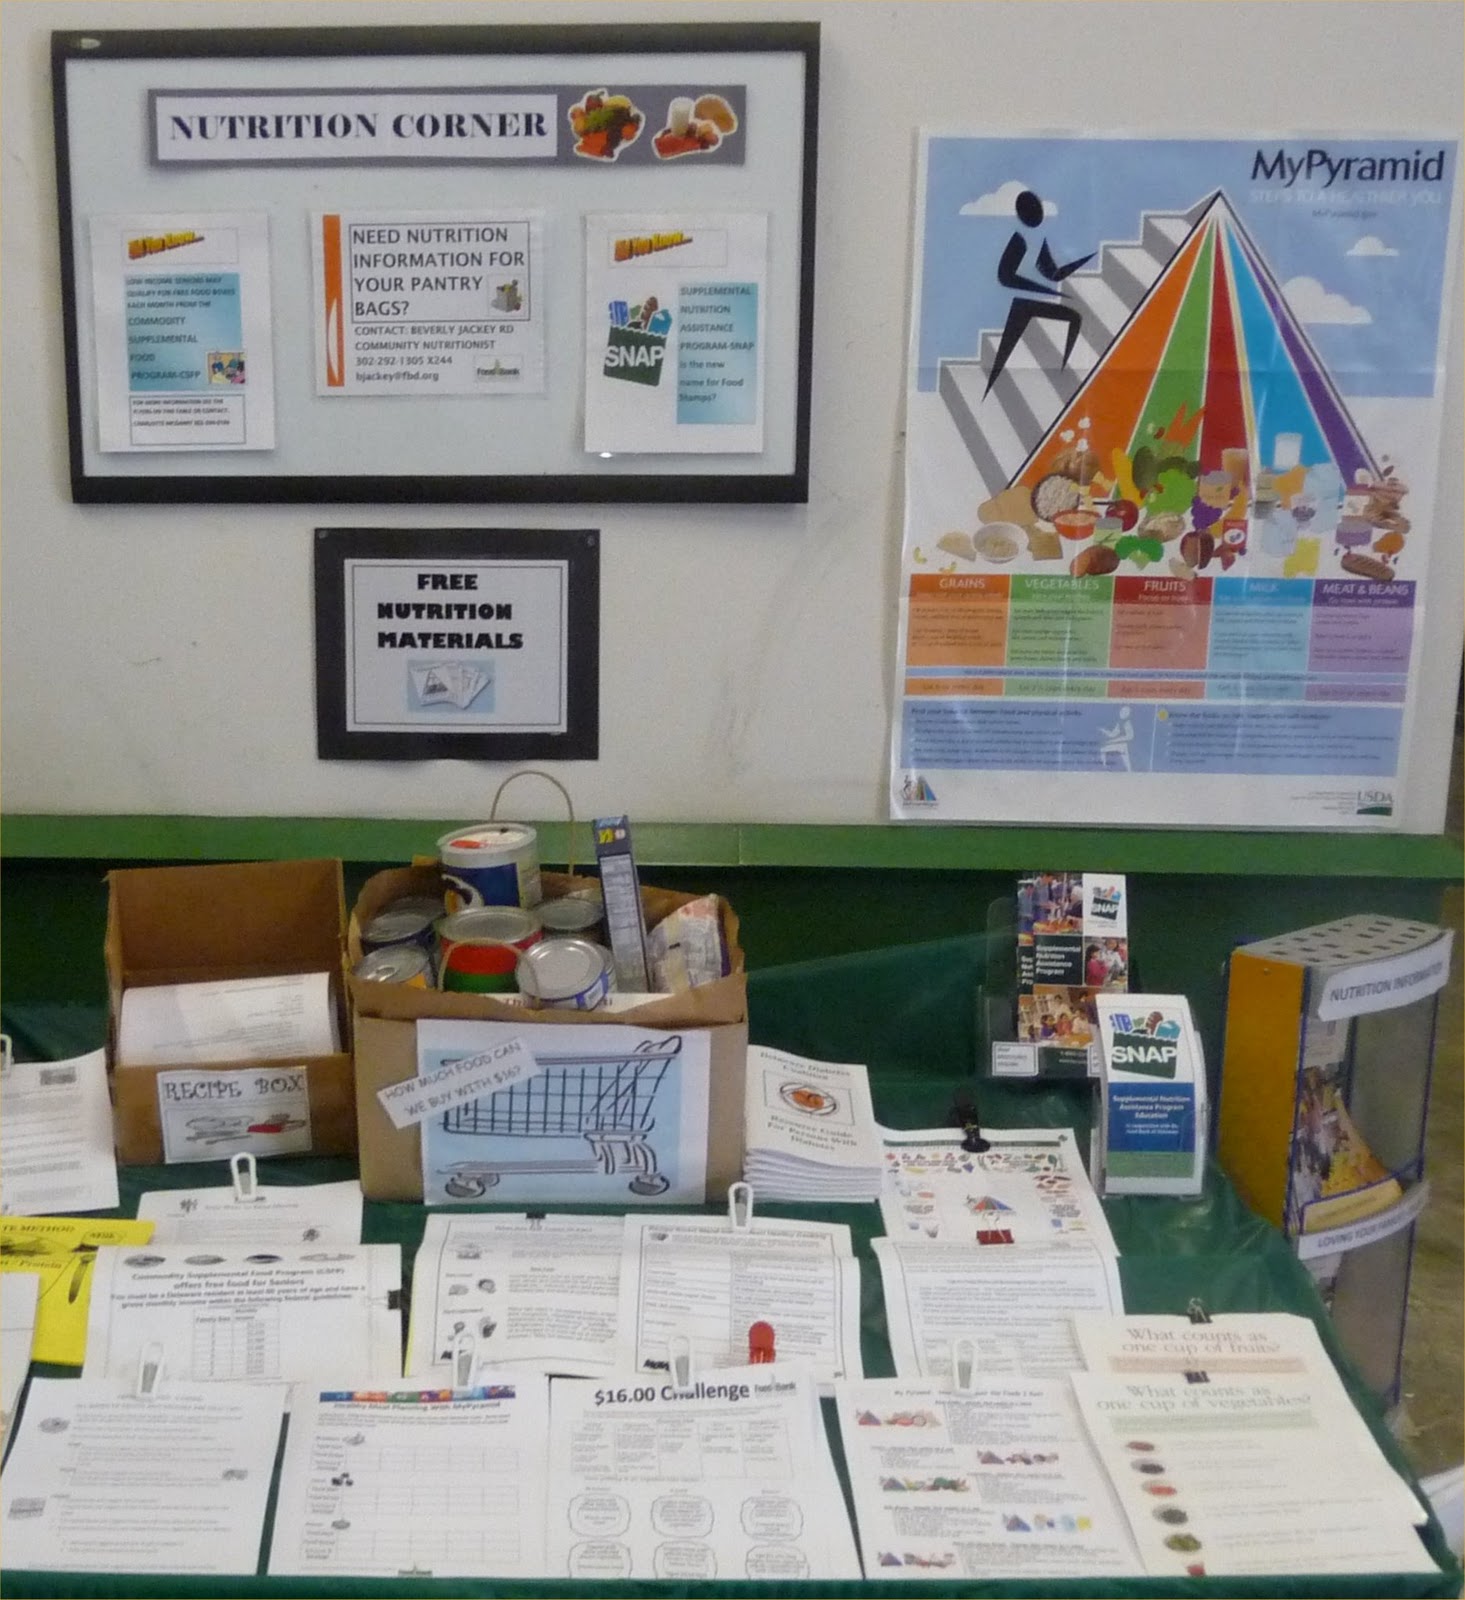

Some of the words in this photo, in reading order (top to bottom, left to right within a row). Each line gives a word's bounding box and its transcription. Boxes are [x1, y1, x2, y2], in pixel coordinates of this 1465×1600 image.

[170, 113, 378, 140] NUTRITION
[392, 111, 548, 138] CORNER
[1251, 149, 1445, 188] MyPyramid
[353, 229, 400, 244] NEED
[407, 227, 508, 243] NUTRITION
[354, 252, 482, 268] INFORMATION
[489, 251, 525, 266] FOR
[354, 277, 404, 292] YOUR
[411, 276, 483, 291] PANTRY
[679, 286, 751, 296] SUPPLEMENTAL
[355, 301, 409, 316] BAGS?
[679, 304, 731, 314] NUTRITION
[128, 316, 187, 326] COMMODITY
[411, 325, 455, 335] BEVERLY
[457, 325, 496, 335] JACKEY
[499, 325, 514, 334] RD
[679, 323, 734, 332] ASSISTANCE
[128, 334, 199, 345] SUPPLEMENTAL
[355, 341, 420, 351] COMMUNITY
[422, 340, 496, 350] NUTRITIONIST
[679, 341, 755, 351] PROGRAM-SNAP
[130, 353, 156, 362] FOOD
[604, 345, 666, 368] SNAP
[689, 360, 704, 369] the
[706, 361, 725, 369] new
[679, 379, 704, 387] name
[706, 378, 720, 387] for
[721, 378, 744, 387] Food
[679, 392, 717, 403] Stamps?
[417, 573, 478, 591] FREE
[938, 578, 986, 590] GRAINS
[1024, 578, 1100, 590] VEGETABLES
[1143, 580, 1187, 592] FRUITS
[1322, 583, 1356, 595] MEAT
[1357, 583, 1367, 595] &
[1368, 584, 1410, 596] BEANS
[377, 602, 512, 620] NUTRITION
[377, 631, 524, 650] MATERIALS
[1357, 791, 1393, 802] USDA
[1091, 902, 1119, 914] SNAP
[1036, 944, 1081, 952] Supplemental
[1036, 952, 1065, 960] Nutrition
[1036, 960, 1073, 968] Assistance
[1036, 967, 1065, 976] Program
[1330, 979, 1392, 1001] NUTRITION
[1110, 1045, 1178, 1065] SNAP
[384, 1082, 416, 1100] HOW
[418, 1069, 456, 1088] MUCH
[455, 1053, 493, 1074] FOOD
[493, 1041, 522, 1059] CAN
[163, 1081, 243, 1102] RECIPE
[254, 1074, 305, 1095] BOX
[404, 1102, 427, 1116] WE
[428, 1091, 452, 1109] BUY
[454, 1077, 492, 1097] WITH
[1154, 1104, 1185, 1112] Program
[20, 1224, 76, 1233] METHOD
[19, 1259, 63, 1270] Protein
[1125, 1327, 1174, 1342] What
[1181, 1329, 1242, 1345] counts
[1248, 1331, 1268, 1342] as
[1121, 1342, 1158, 1353] one
[1163, 1342, 1198, 1355] cup
[594, 1387, 656, 1407] $16.00
[1125, 1384, 1176, 1399] What
[1183, 1386, 1241, 1399] counts
[1252, 1387, 1272, 1398] as
[1095, 1400, 1129, 1411] one
[1139, 1399, 1176, 1413] cup
